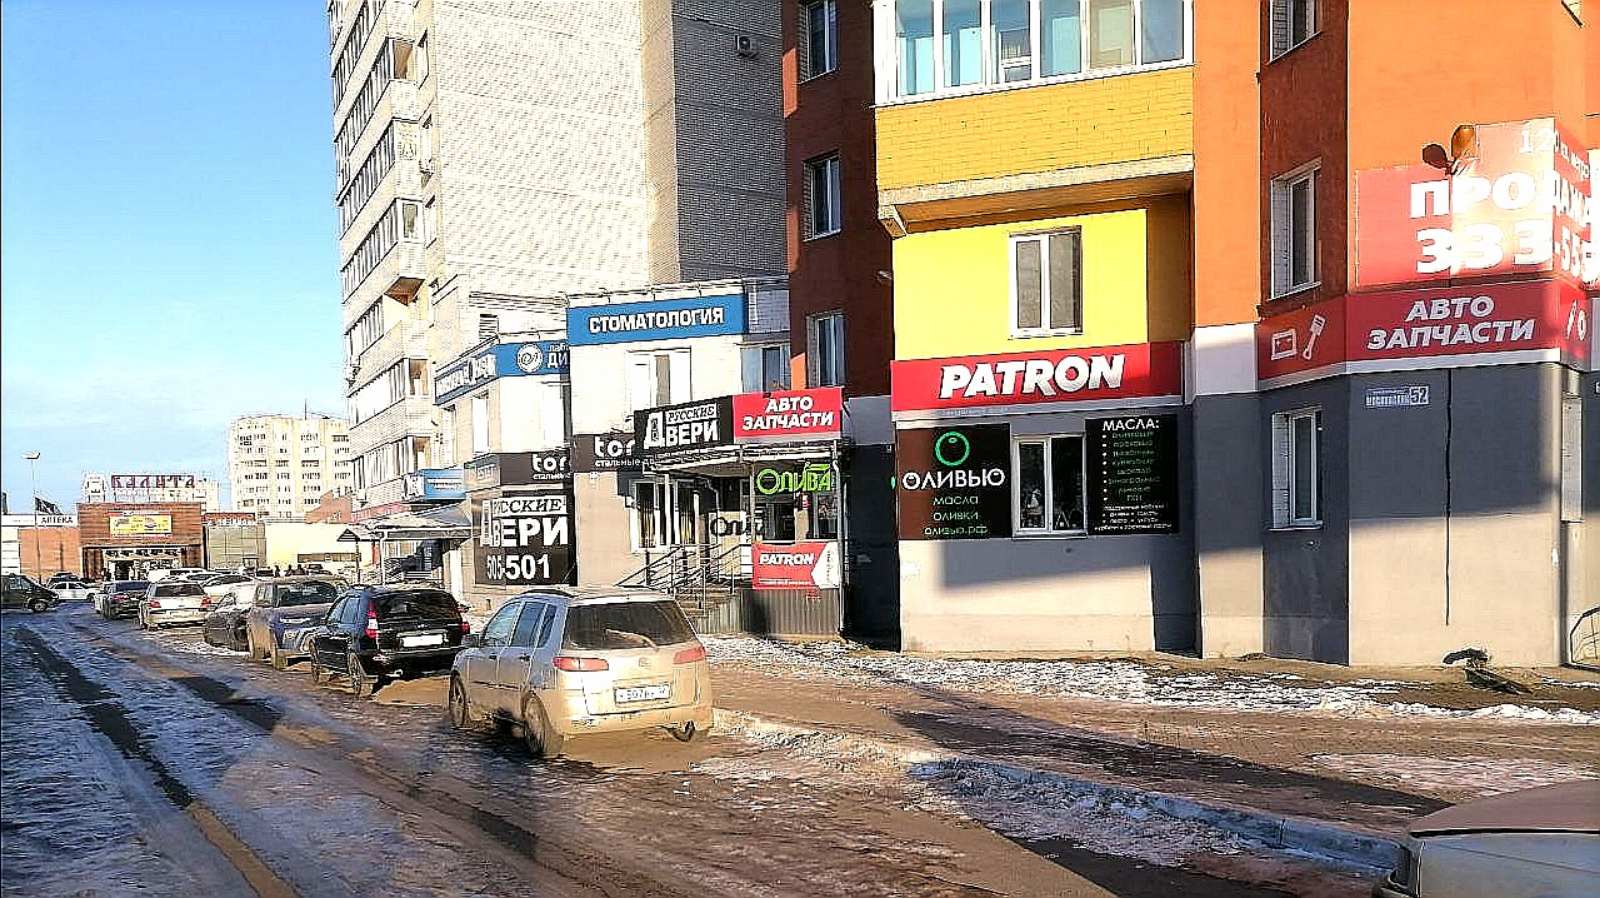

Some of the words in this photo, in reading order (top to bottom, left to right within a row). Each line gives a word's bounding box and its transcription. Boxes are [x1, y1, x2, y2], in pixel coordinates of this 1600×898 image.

[1405, 296, 1495, 322] АВТО
[589, 307, 724, 334] СТОМАТОЛОГИЯ
[1367, 319, 1535, 350] ЗАПЧАСТИ
[939, 354, 1126, 399] PATRON
[765, 396, 813, 413] АВТО
[1410, 386, 1428, 404] 52
[668, 406, 715, 422] РУССКИЕ
[742, 412, 834, 431] ЗАПЧАСТИ
[643, 411, 719, 450] ДВЕРИ
[1102, 418, 1159, 431] МАСЛА:
[902, 468, 1006, 491] ОЛИВЬЮ
[40, 515, 74, 525] АПТЕКА
[760, 552, 815, 566] PATRON
